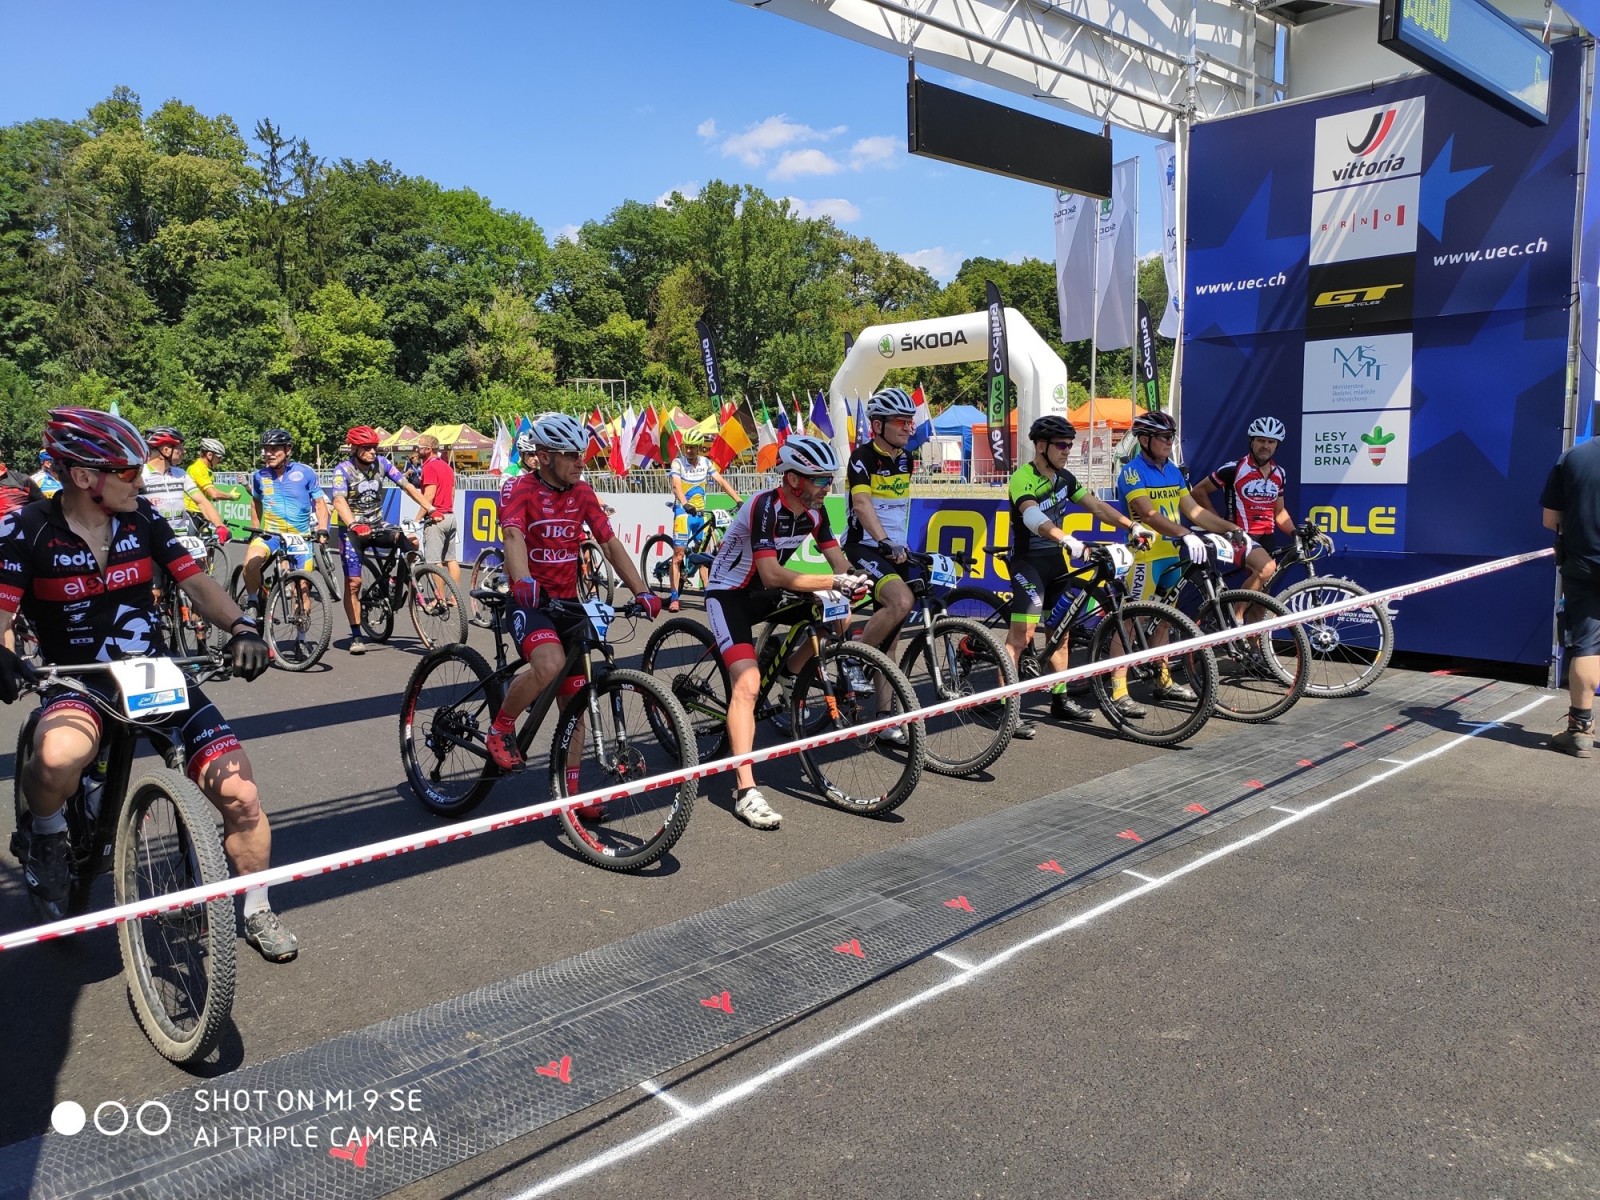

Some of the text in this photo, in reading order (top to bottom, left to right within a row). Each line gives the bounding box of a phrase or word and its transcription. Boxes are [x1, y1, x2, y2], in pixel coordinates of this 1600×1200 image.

[1332, 154, 1405, 181] vittoria
[1433, 237, 1549, 267] www.uec.ch
[1195, 272, 1287, 296] www.uec.ch
[1314, 283, 1404, 306] GT
[901, 330, 968, 352] ŠKODA
[1315, 431, 1347, 442] LESY
[1314, 443, 1358, 454] MĚSTA
[1314, 456, 1351, 466] BRNA
[715, 510, 728, 519] 24
[541, 525, 575, 538] JBG
[182, 539, 199, 550] 26
[1215, 536, 1227, 549] 6
[938, 555, 949, 572] 3
[1117, 547, 1128, 565] 2
[594, 603, 611, 625] 5
[134, 662, 156, 690] 7
